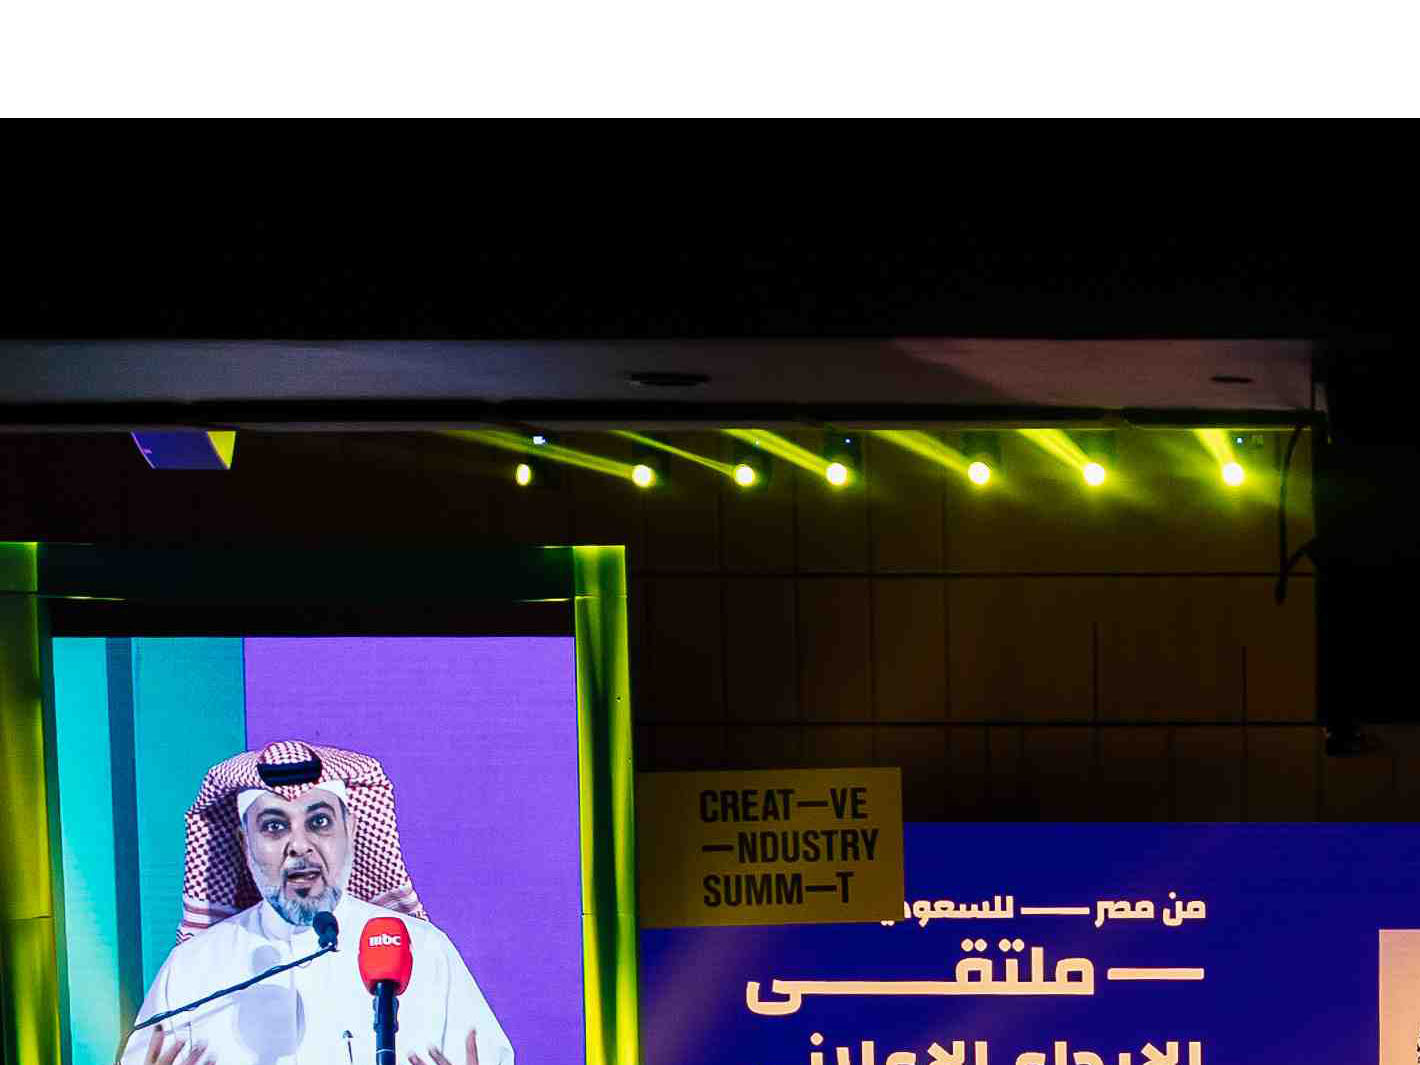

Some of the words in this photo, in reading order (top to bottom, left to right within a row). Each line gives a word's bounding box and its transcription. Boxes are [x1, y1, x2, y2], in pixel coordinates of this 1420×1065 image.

[1094, 900, 1155, 928] مصر
[1162, 891, 1206, 927] من
[745, 938, 1095, 1016] ملتقى
